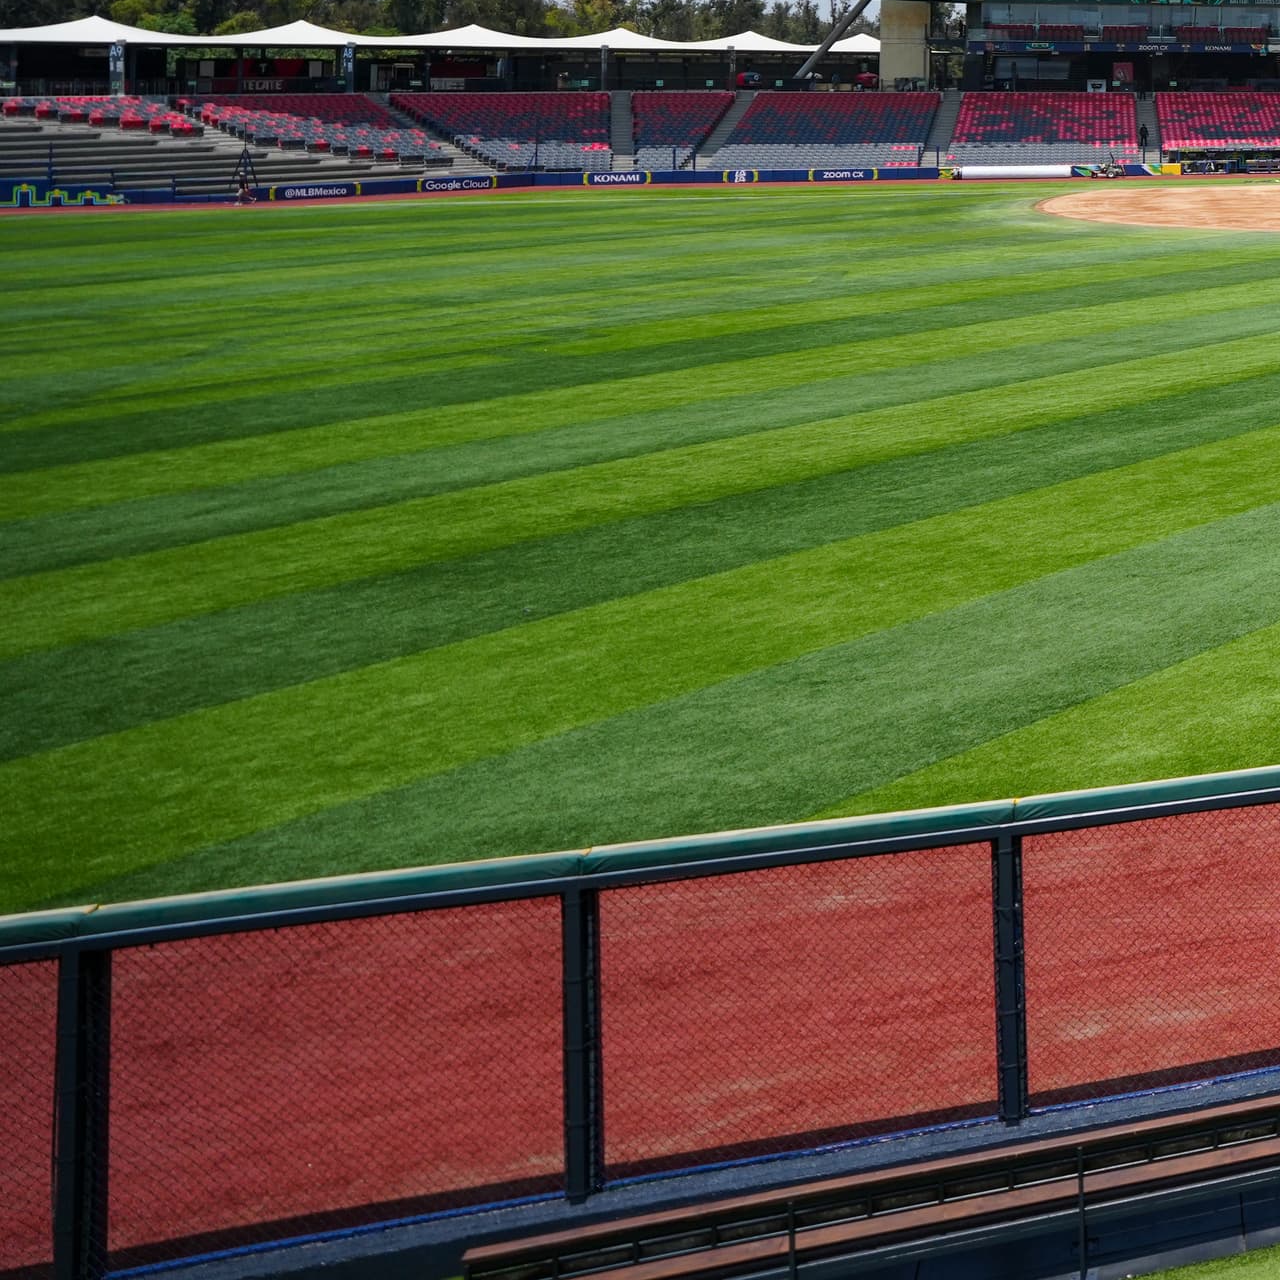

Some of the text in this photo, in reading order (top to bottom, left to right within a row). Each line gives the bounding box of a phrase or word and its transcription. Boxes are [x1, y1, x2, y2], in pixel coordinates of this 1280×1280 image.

[110, 45, 122, 58] A9
[594, 173, 640, 182] KONAMI
[426, 179, 490, 191] Google Cloud
[284, 186, 347, 198] @MLBMexico
